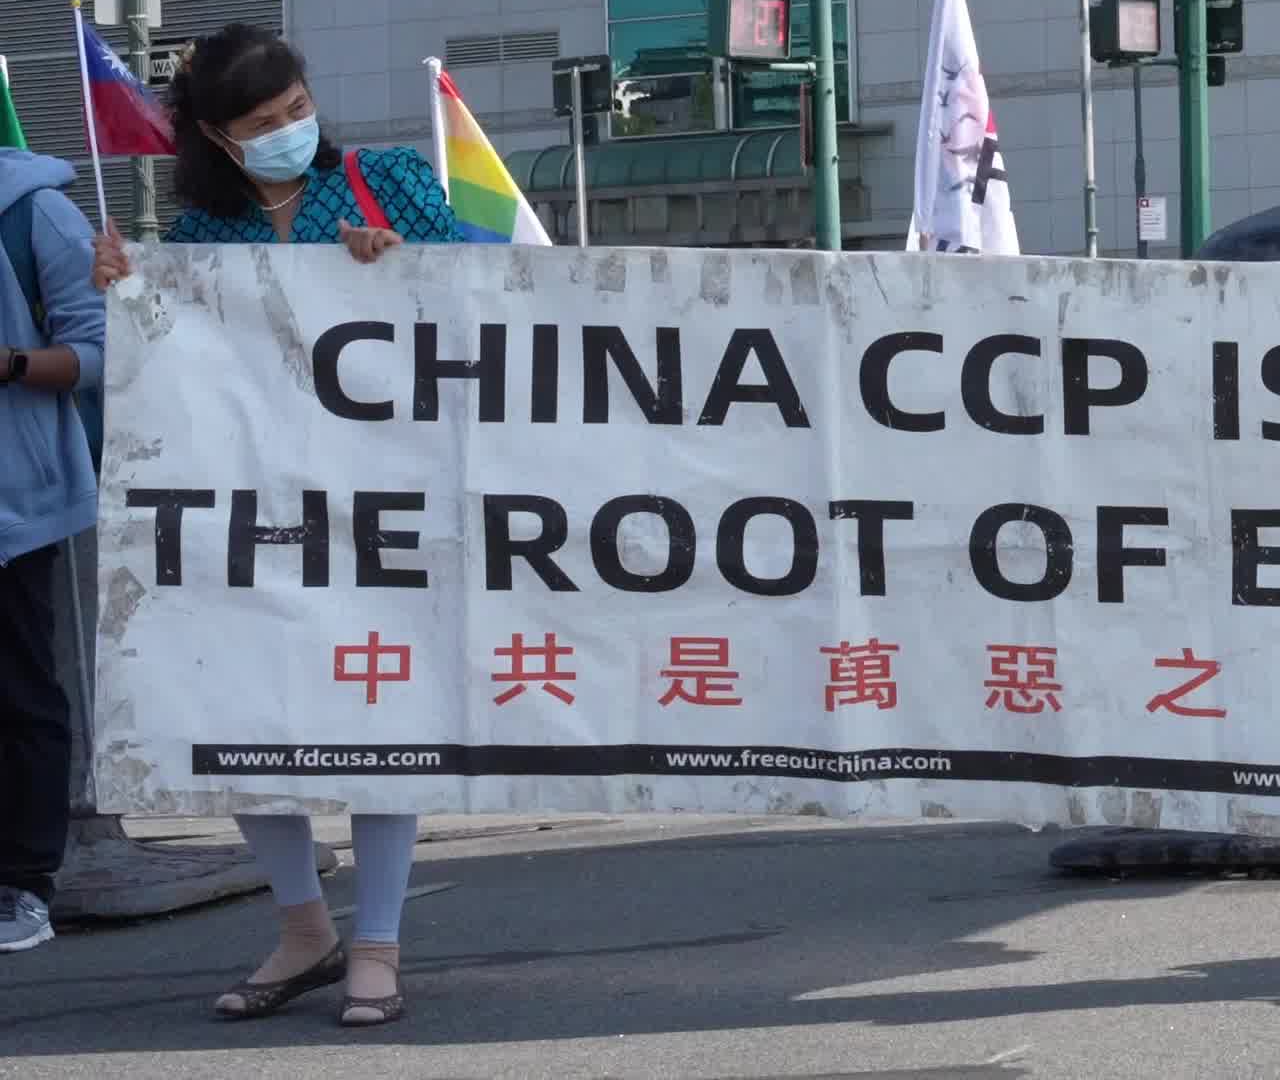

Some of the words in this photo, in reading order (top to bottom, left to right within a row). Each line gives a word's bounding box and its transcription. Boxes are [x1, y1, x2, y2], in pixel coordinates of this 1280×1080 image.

[153, 59, 175, 74] WA
[313, 320, 812, 429] CHINA
[859, 331, 1150, 436] CCP
[125, 488, 429, 589] THE
[483, 492, 914, 599] ROOT
[969, 502, 1169, 603] OF
[217, 748, 441, 767] www.fdcusa.com
[666, 749, 951, 772] www.freeourchina.com
